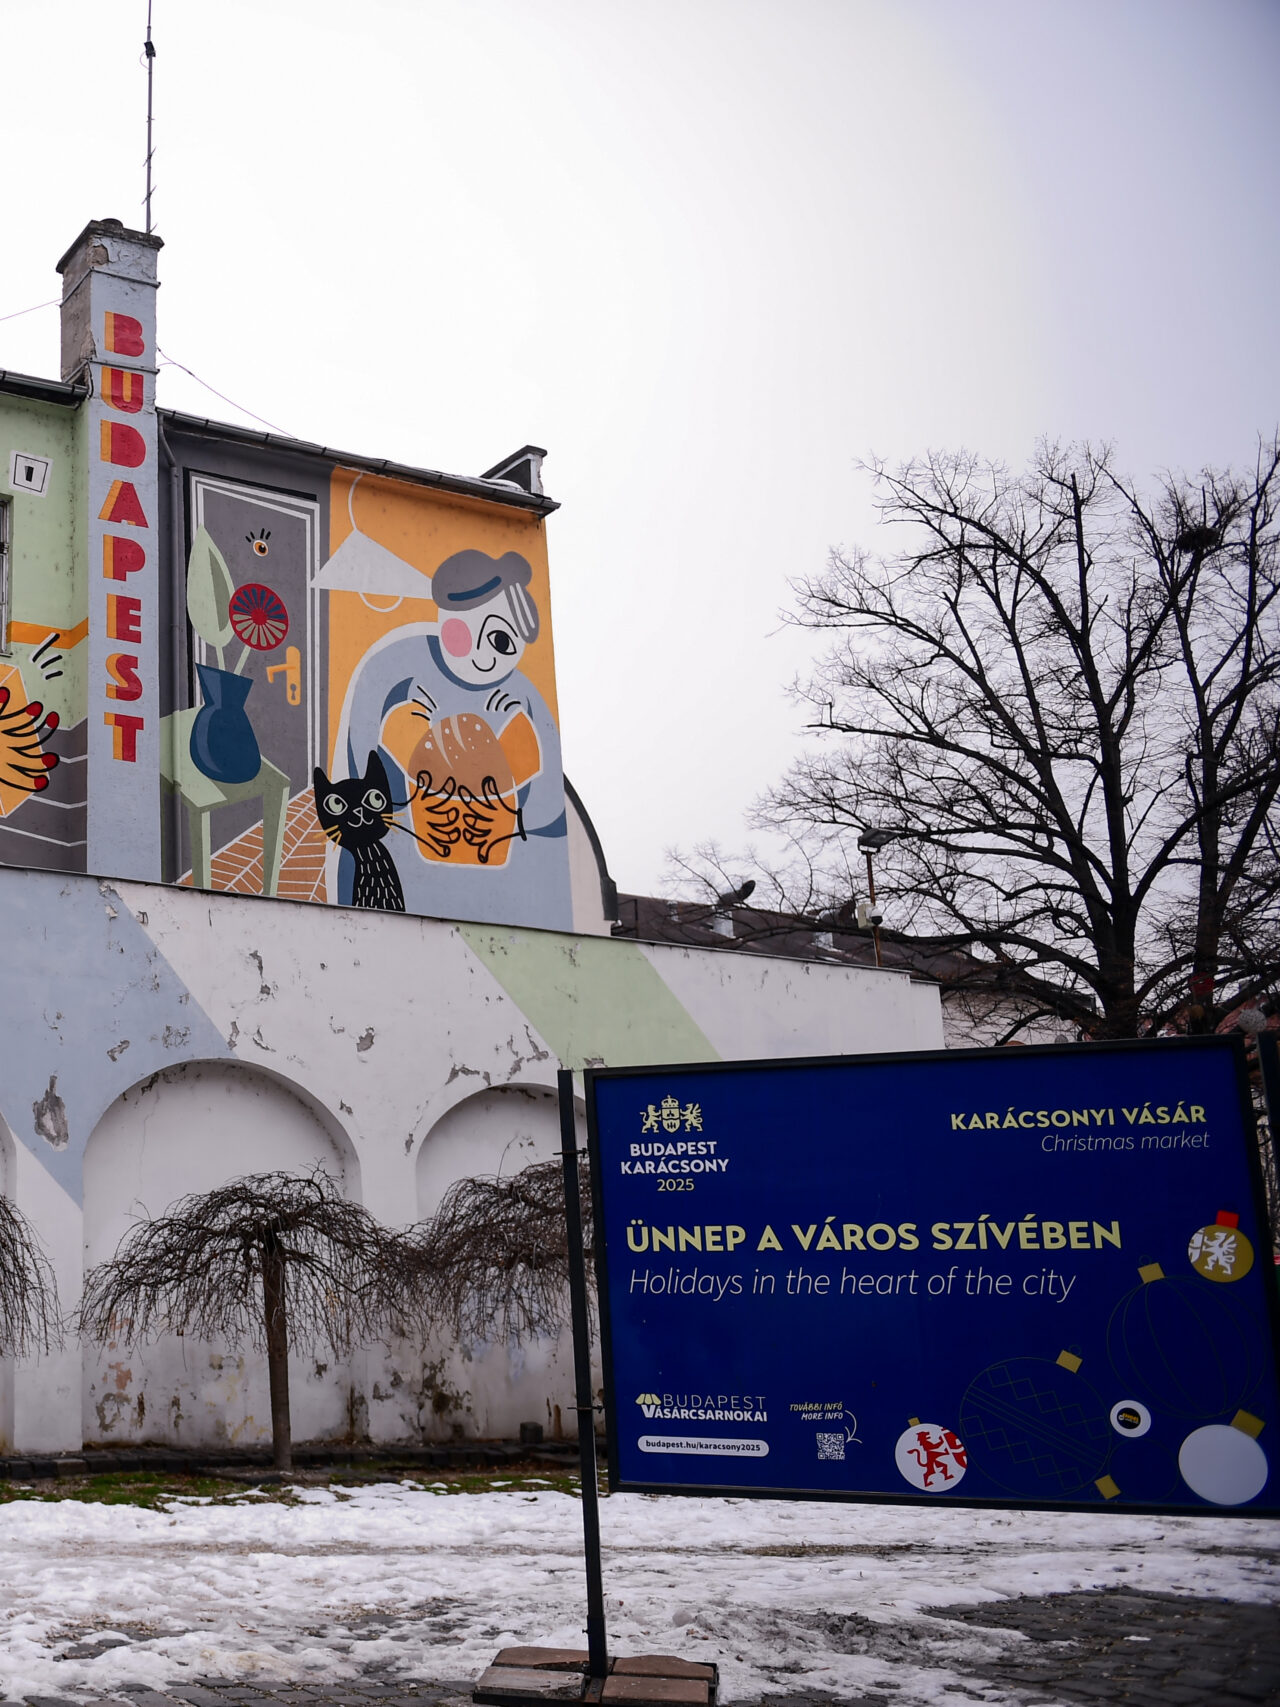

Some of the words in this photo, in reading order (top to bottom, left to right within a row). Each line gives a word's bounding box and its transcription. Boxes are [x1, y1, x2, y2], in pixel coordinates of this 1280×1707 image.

[98, 311, 149, 763] BUDAPEST
[950, 1106, 1115, 1130] KARÁCSONYI
[1121, 1101, 1207, 1126] VÁSÁR
[629, 1141, 718, 1157] BUDAPEST
[1041, 1133, 1135, 1152] Christmas
[1141, 1130, 1211, 1150] market
[620, 1157, 730, 1175] KARÁCSONY
[656, 1178, 695, 1192] 2025
[626, 1219, 746, 1252] ÜNNEP
[756, 1224, 784, 1251] A
[791, 1216, 920, 1251] VÁROS
[931, 1213, 1122, 1250] SZÍVÉBEN
[629, 1266, 743, 1302] Holidays
[752, 1268, 776, 1295] in
[786, 1266, 831, 1295] the
[840, 1266, 920, 1295] heart
[927, 1265, 959, 1296] of
[965, 1267, 1014, 1295] the
[1022, 1269, 1077, 1303] city
[663, 1393, 766, 1410] BUDAPEST
[789, 1401, 823, 1411] TOVÁBBI
[824, 1401, 843, 1411] INFÓ
[641, 1404, 768, 1422] VÁSÁRCSARNOKAI
[801, 1411, 824, 1421] MORE
[824, 1411, 844, 1420] INFO
[645, 1439, 761, 1453] budapest.hu/karacsony2025
